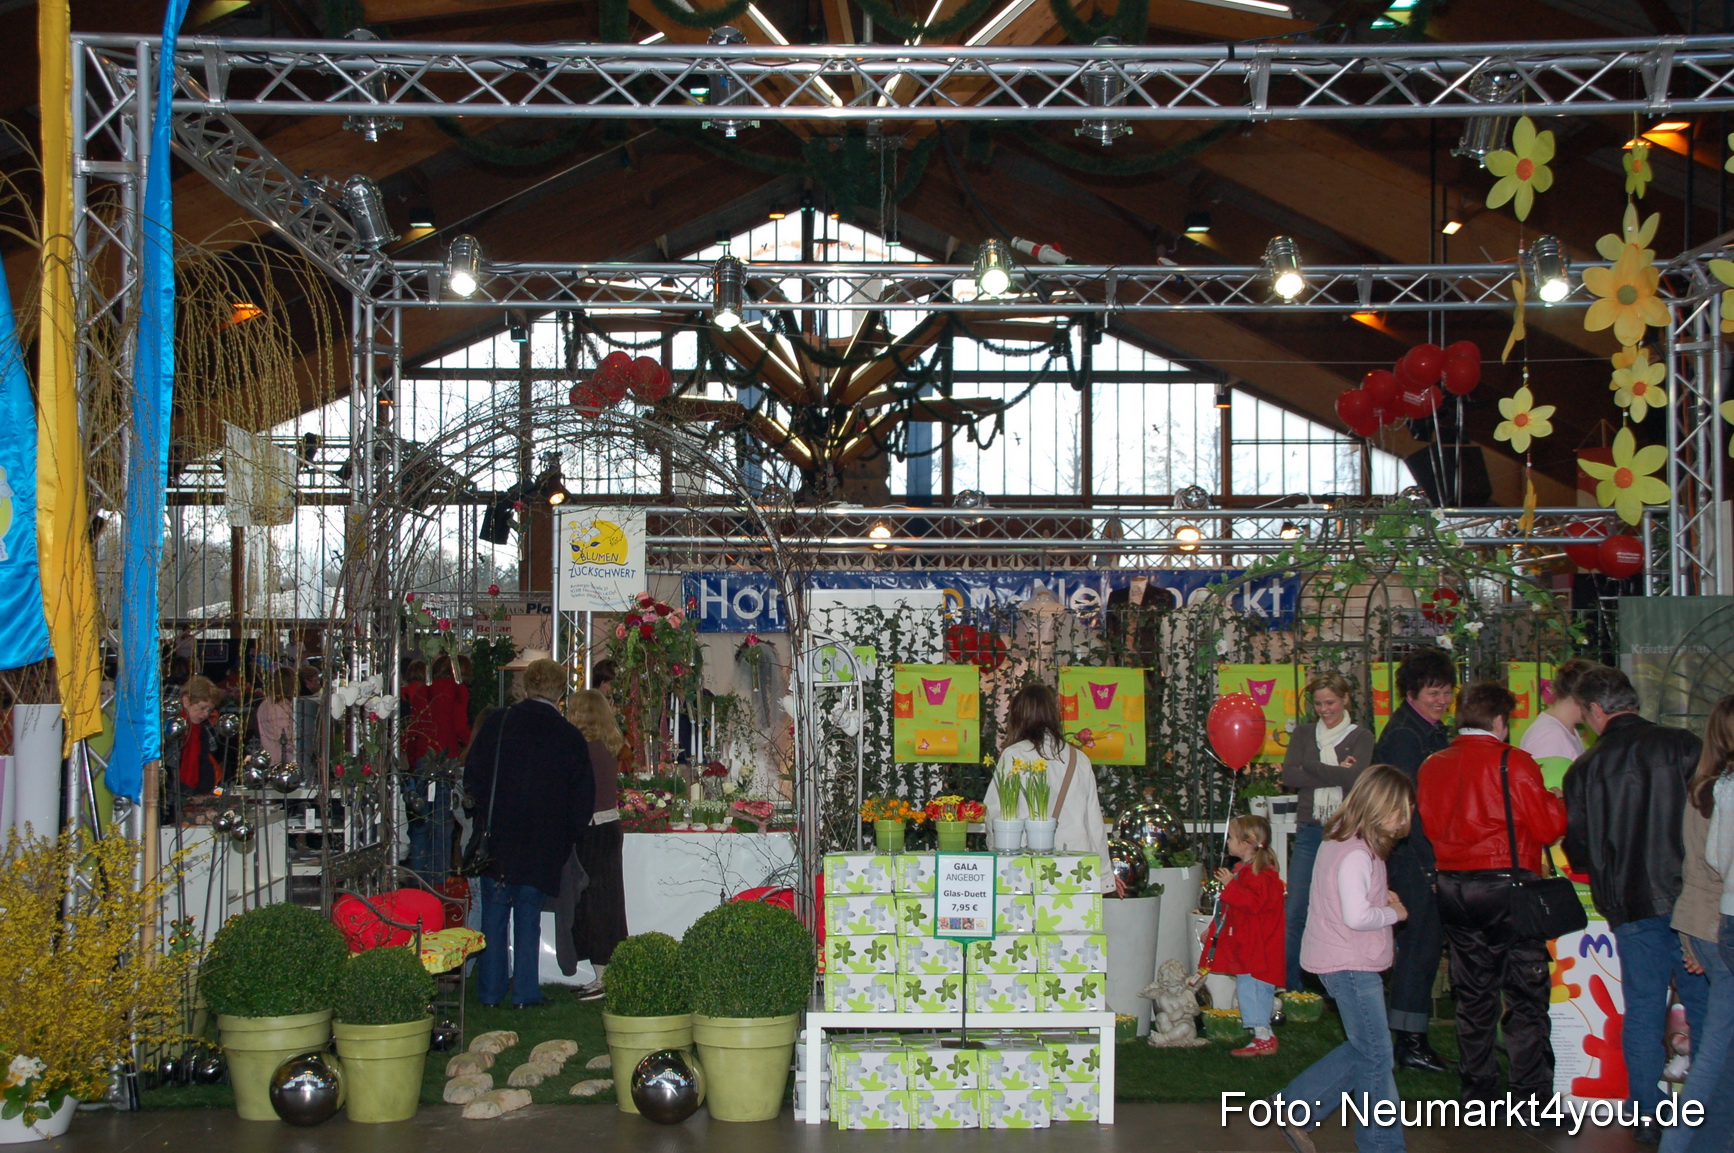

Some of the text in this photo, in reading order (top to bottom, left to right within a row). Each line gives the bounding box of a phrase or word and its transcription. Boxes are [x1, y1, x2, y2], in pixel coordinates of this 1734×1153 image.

[580, 552, 620, 562] BLUMEN
[568, 566, 637, 579] ZUCKSCHWERT
[953, 863, 978, 871] GALA
[946, 874, 986, 882] ANGEBOT
[943, 890, 987, 898] Glas-Duett
[951, 904, 970, 912] 7,95
